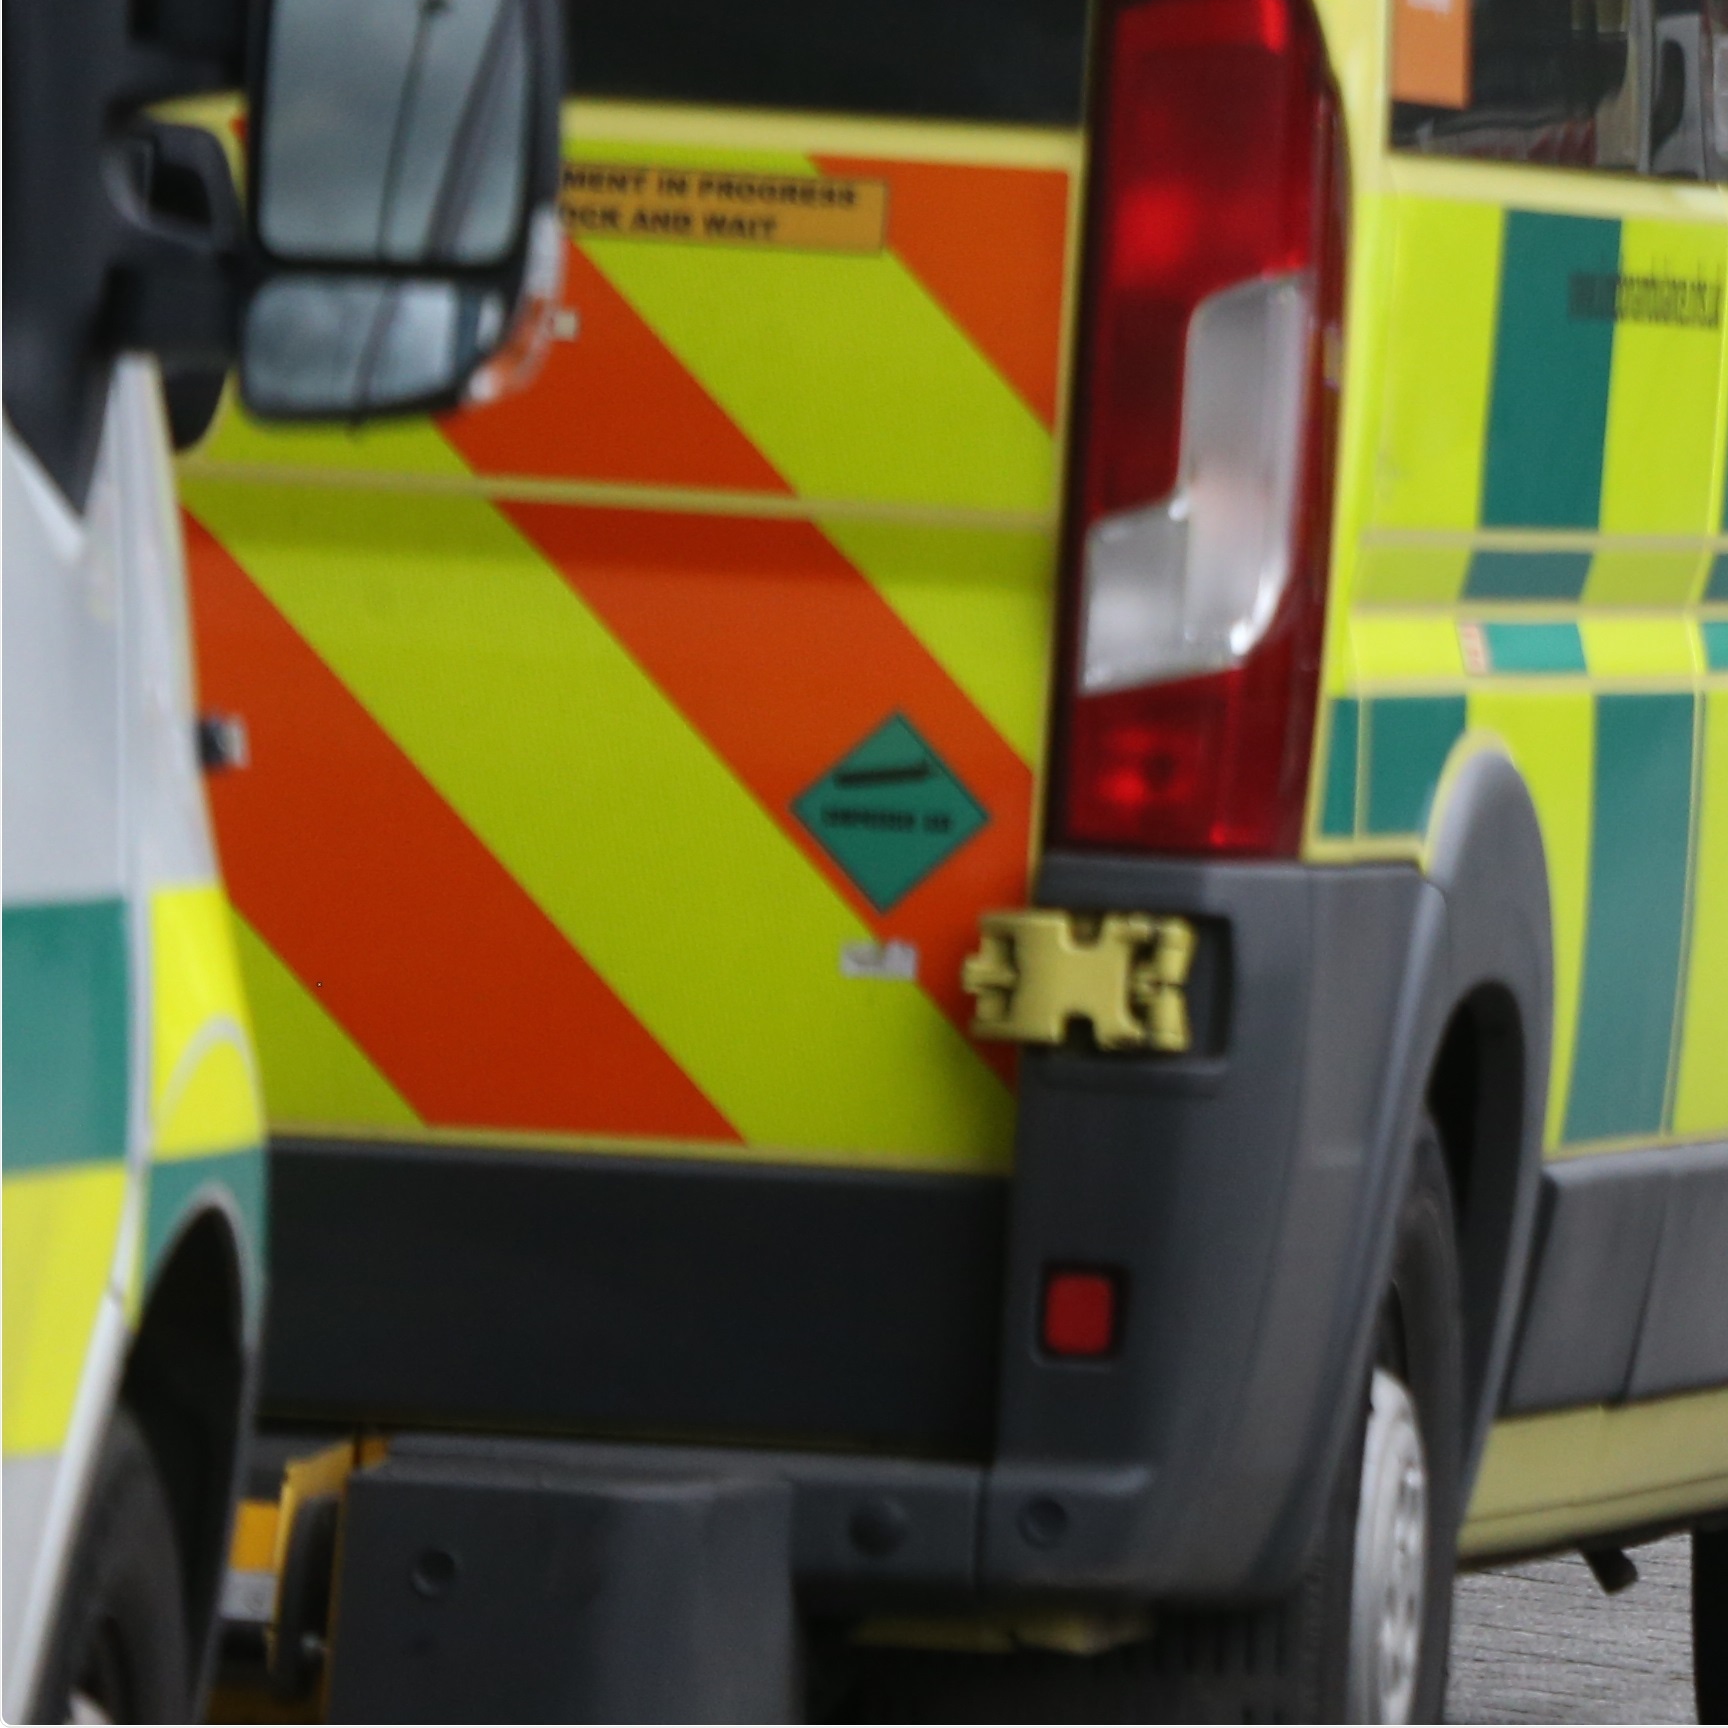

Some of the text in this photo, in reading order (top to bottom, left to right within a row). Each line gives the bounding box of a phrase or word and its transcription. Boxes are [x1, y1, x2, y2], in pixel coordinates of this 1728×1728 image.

[658, 175, 687, 195] IN
[698, 178, 856, 207] PROGRESS
[632, 209, 692, 234] AND
[703, 213, 778, 239] WAIT
